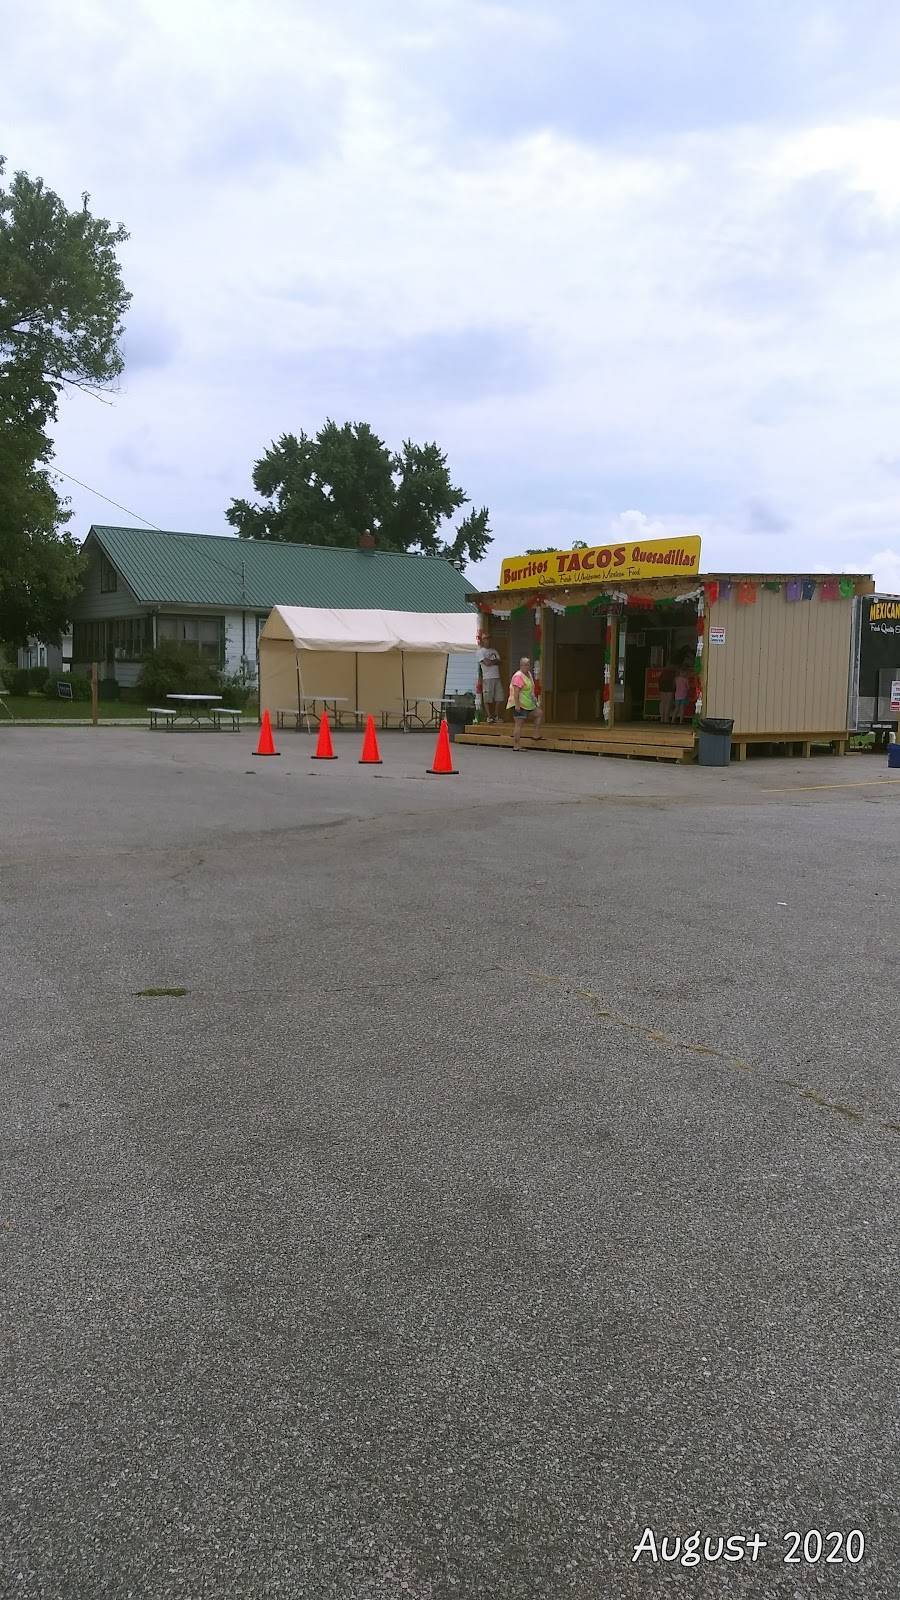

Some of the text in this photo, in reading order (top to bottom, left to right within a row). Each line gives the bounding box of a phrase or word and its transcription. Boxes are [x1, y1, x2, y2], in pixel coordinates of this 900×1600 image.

[503, 546, 696, 584] Burritos TACOS Quesadillas
[575, 572, 601, 582] Wholes
[626, 566, 641, 577] Food
[869, 602, 900, 621] MEXICAN
